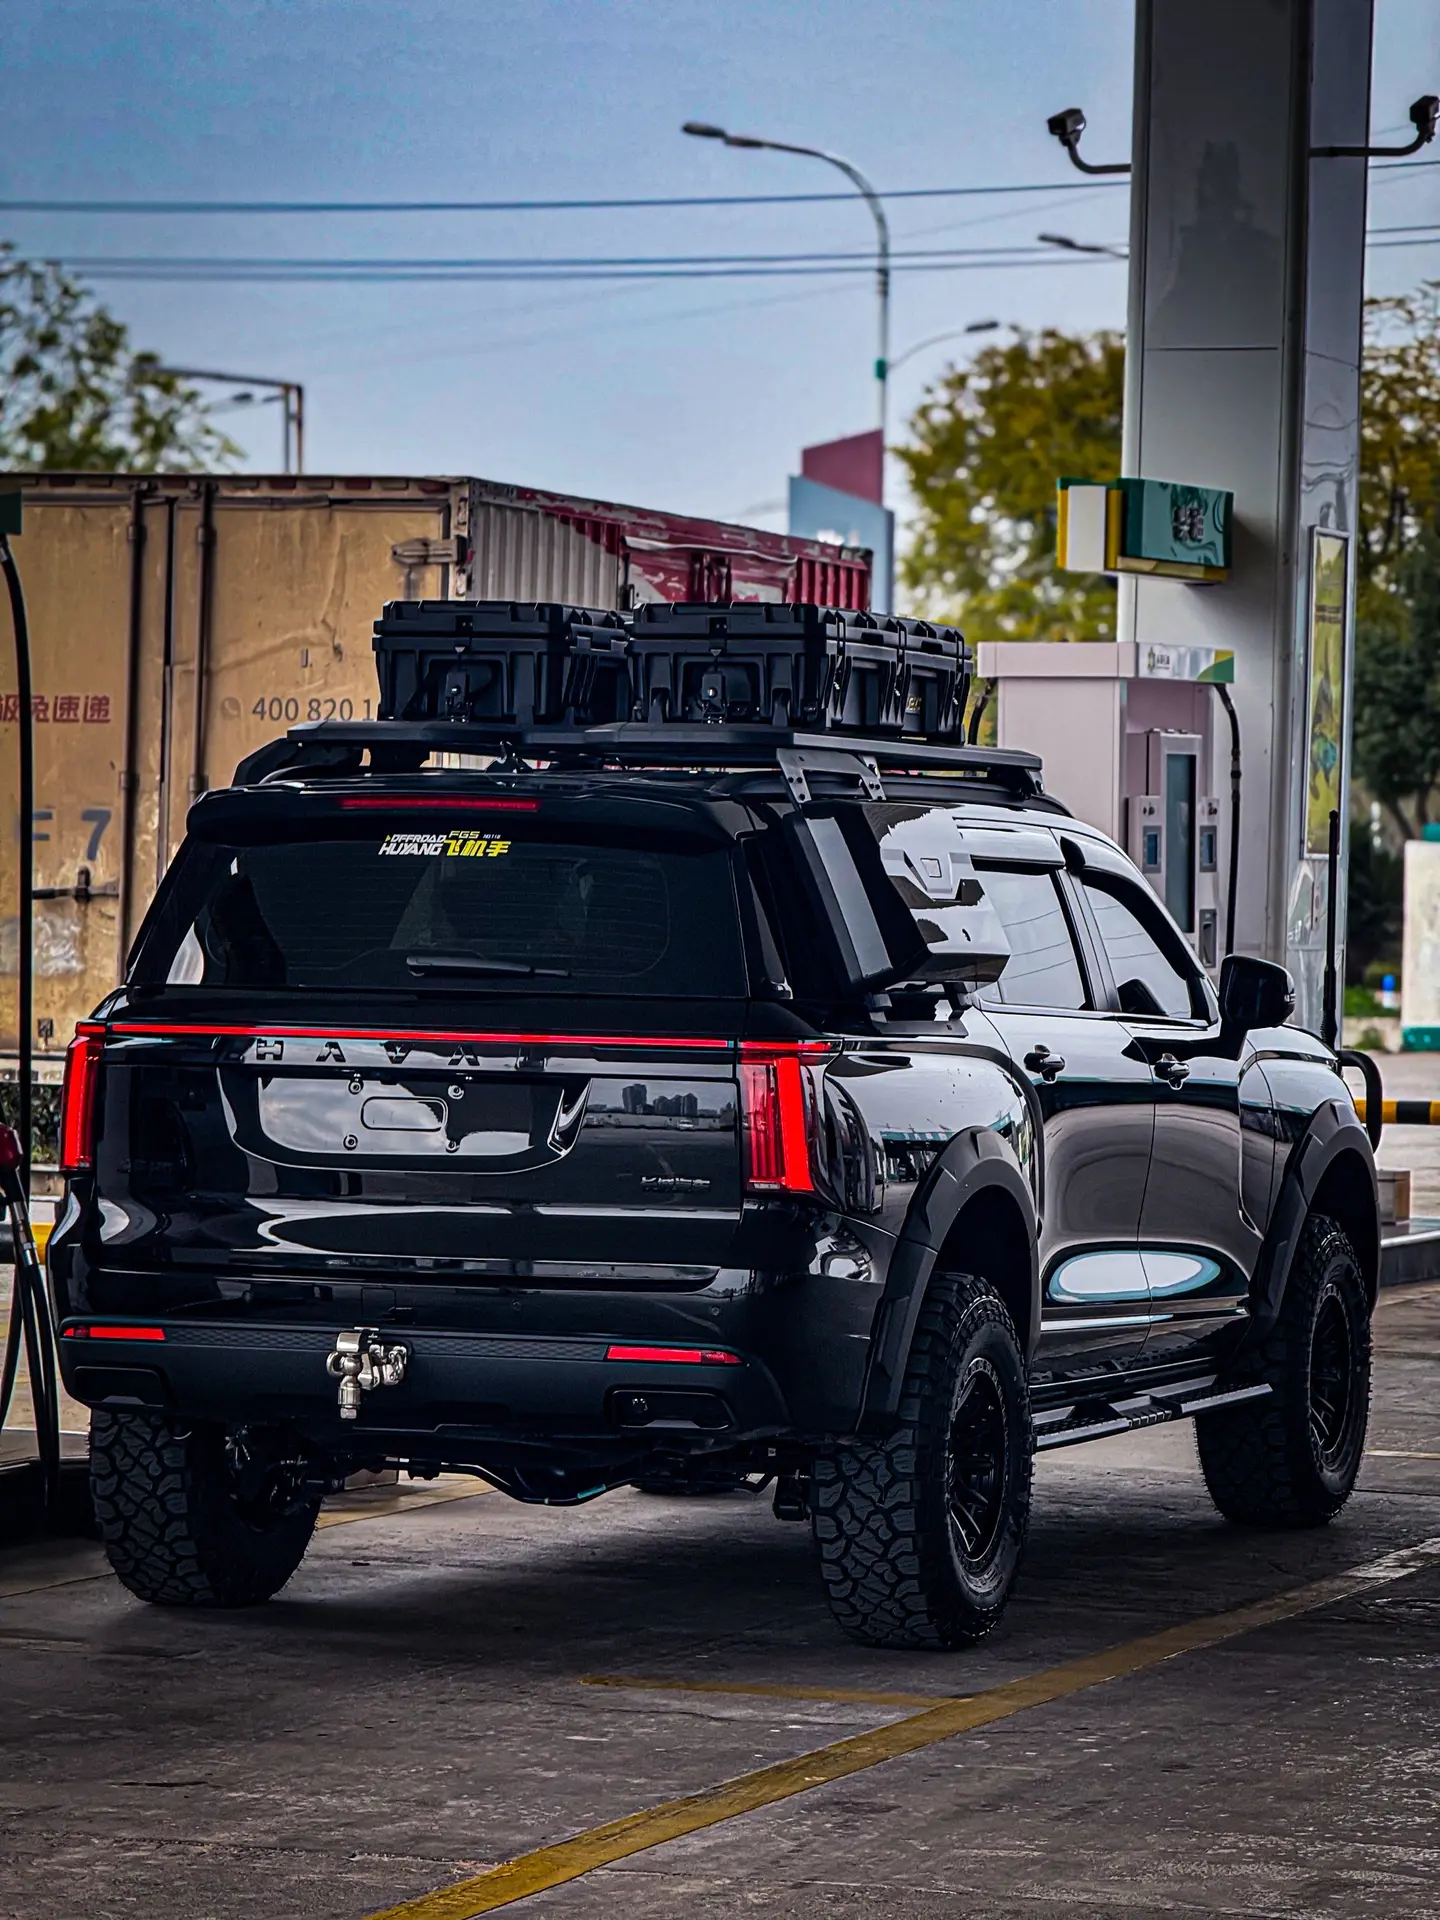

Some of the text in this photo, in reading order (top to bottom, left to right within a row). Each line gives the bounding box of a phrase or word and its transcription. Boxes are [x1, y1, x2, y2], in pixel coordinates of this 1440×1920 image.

[252, 697, 299, 721] 400
[307, 698, 353, 721] 820
[82, 808, 112, 861] 7
[390, 834, 447, 843] OFFROAD
[449, 831, 480, 839] FGS
[378, 843, 443, 855] HUYANG
[444, 840, 511, 857] 飞机手
